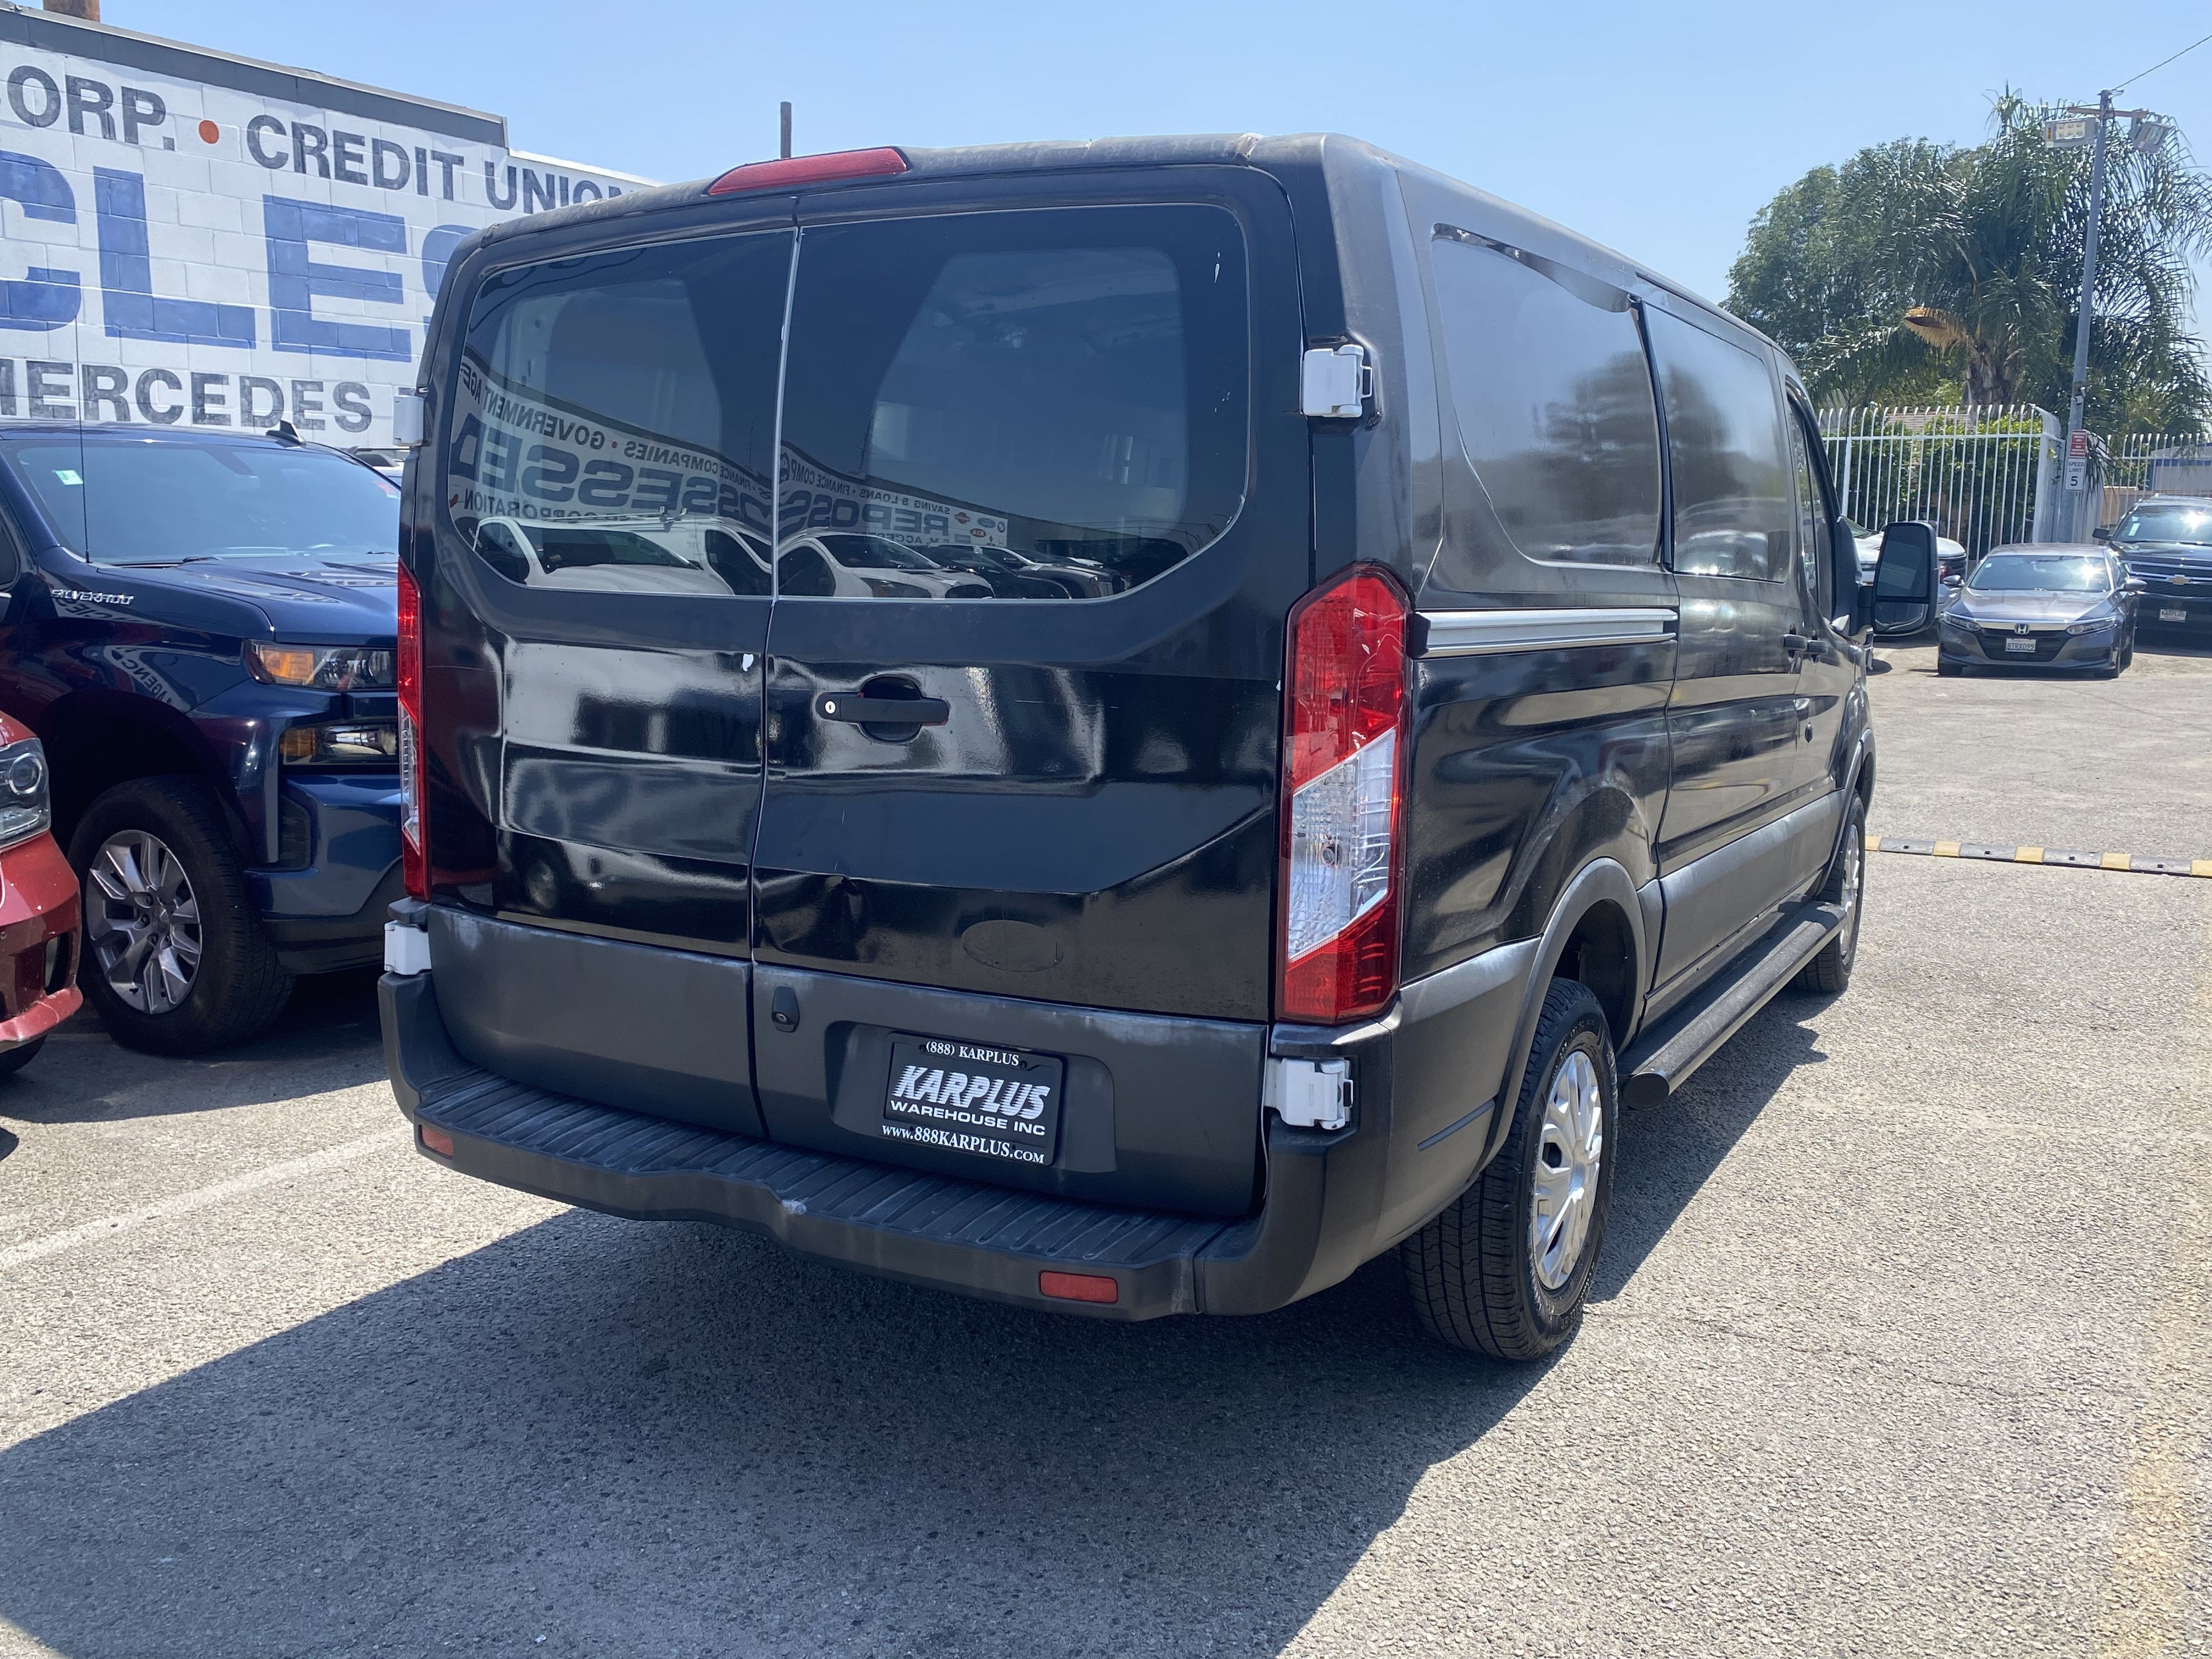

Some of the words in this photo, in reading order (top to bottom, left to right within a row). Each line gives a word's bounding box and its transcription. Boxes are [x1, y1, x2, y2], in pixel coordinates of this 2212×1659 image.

[0, 65, 175, 151] ORP.
[247, 114, 465, 201] CREDIT
[2070, 476, 2078, 486] 5
[52, 589, 134, 605] SILVERADO
[926, 1041, 955, 1056] (888)
[958, 1045, 1019, 1066] KARPLUS
[891, 1065, 1051, 1119] KARPLUS
[890, 1100, 1008, 1129] WAREHOUSE
[1014, 1121, 1046, 1136] INC
